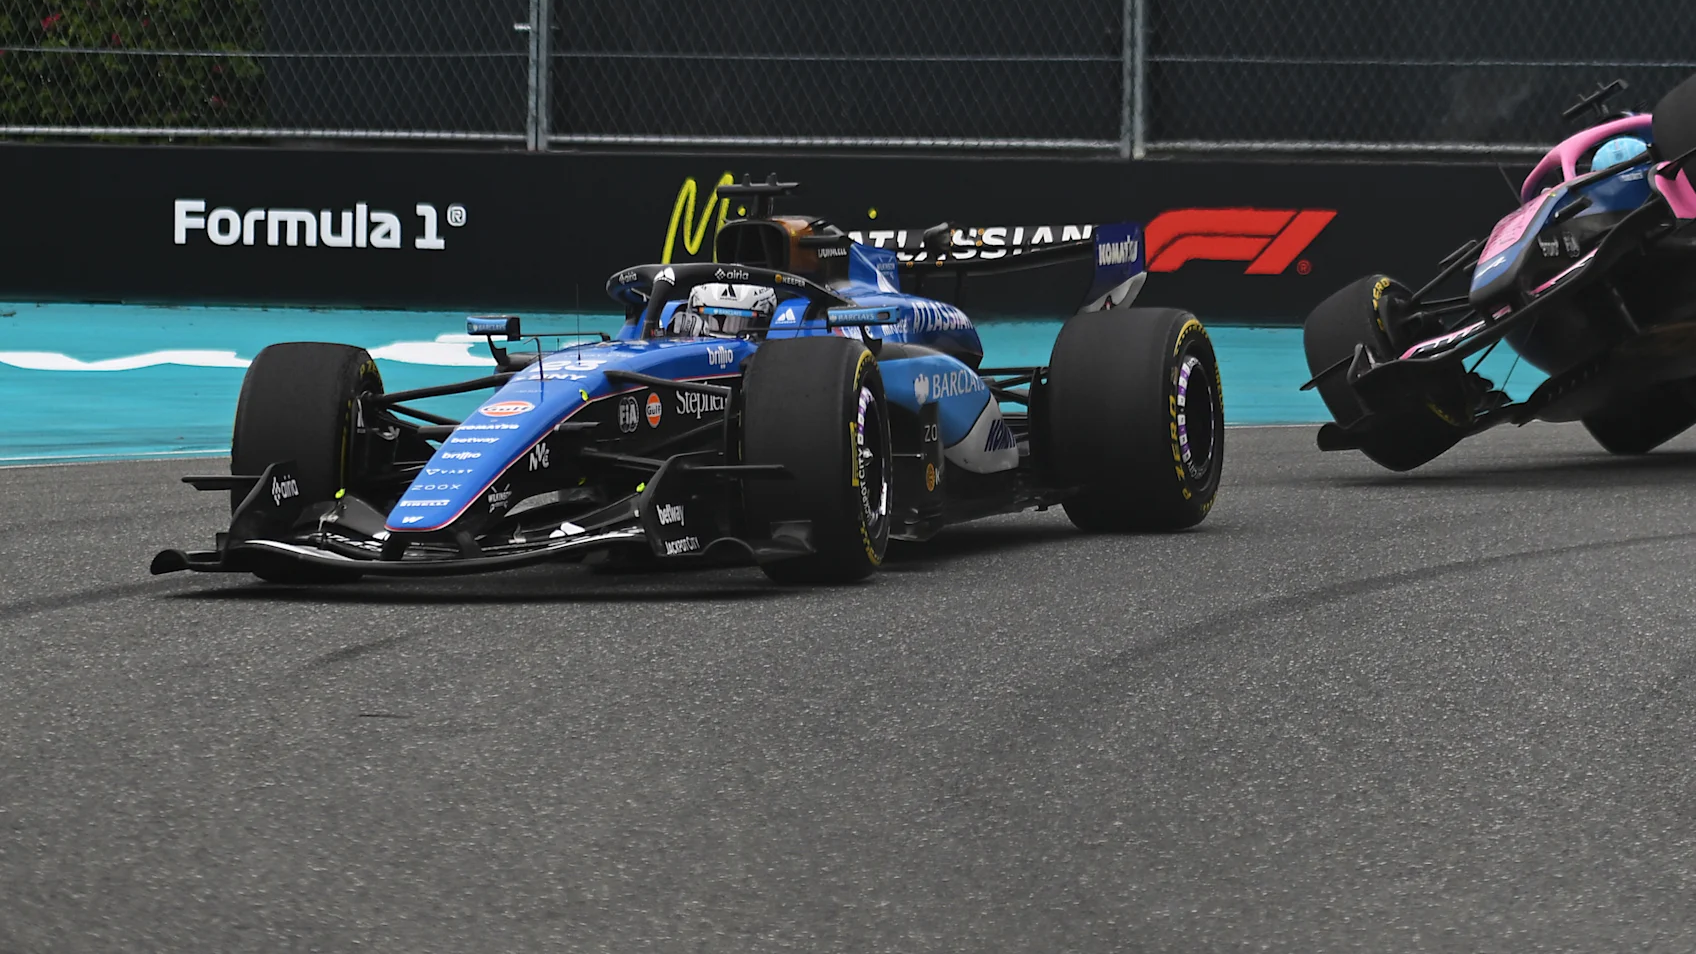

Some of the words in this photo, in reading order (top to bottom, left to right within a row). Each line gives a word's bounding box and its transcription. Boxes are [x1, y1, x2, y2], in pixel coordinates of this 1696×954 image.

[174, 199, 401, 248] Formula
[1144, 207, 1338, 274] F1
[932, 370, 985, 399] BARCLAYS
[450, 437, 500, 445] betway
[411, 483, 462, 491] ZOOX
[656, 503, 685, 526] betway
